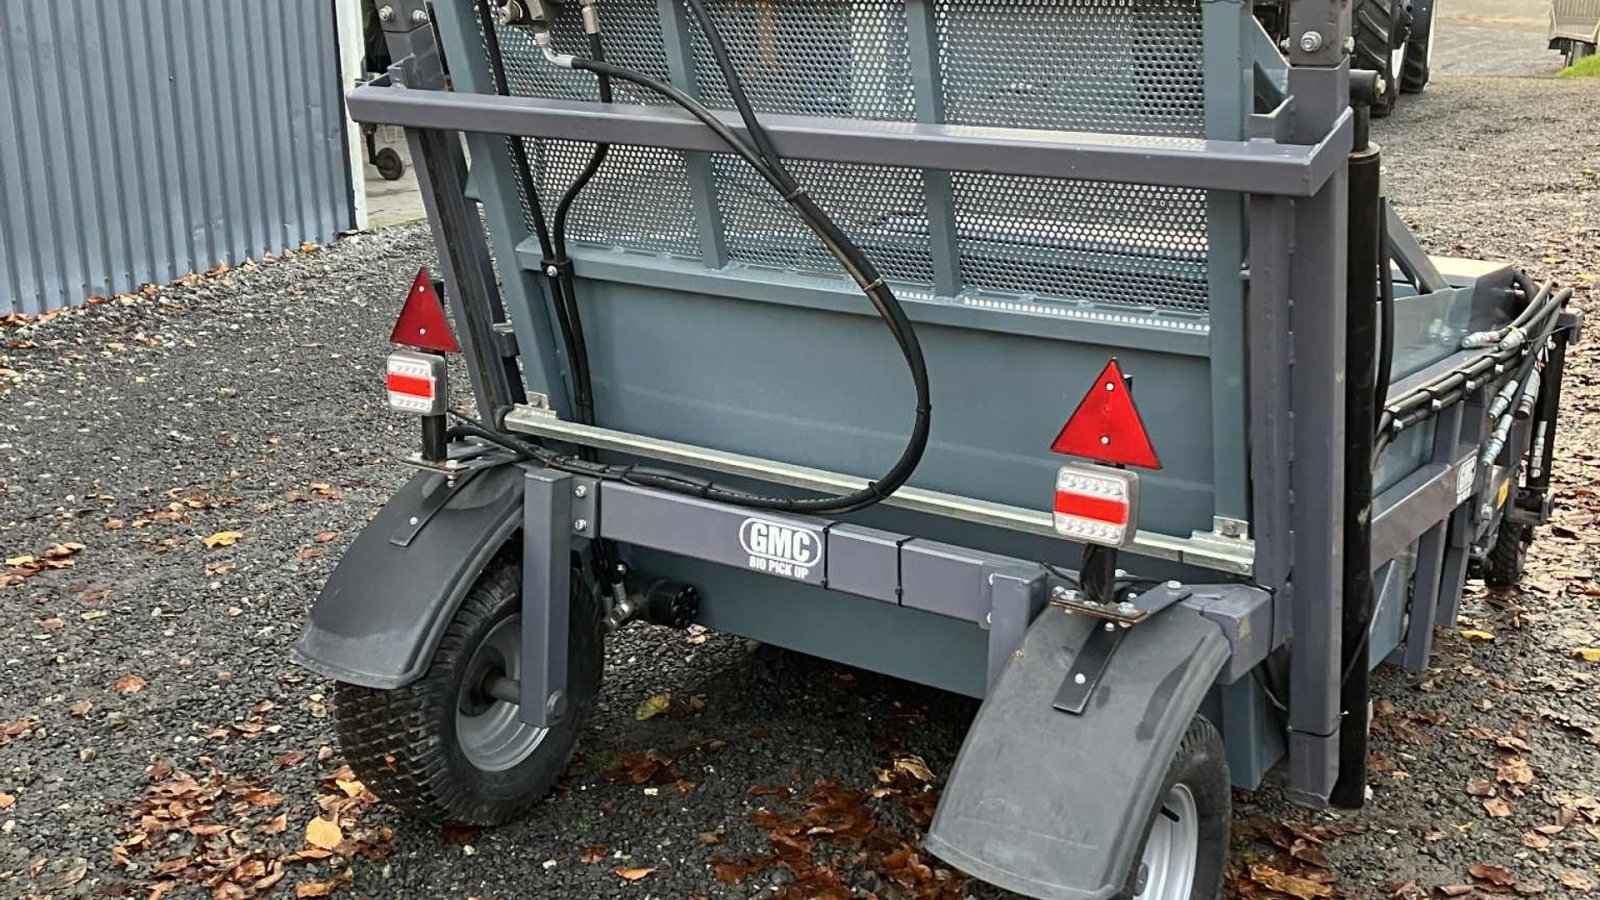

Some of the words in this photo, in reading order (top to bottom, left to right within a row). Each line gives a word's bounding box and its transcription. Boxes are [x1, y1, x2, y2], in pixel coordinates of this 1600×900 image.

[750, 522, 811, 562] GMC
[749, 555, 767, 570] BIO
[768, 560, 793, 576] PICK
[793, 565, 809, 579] UP
